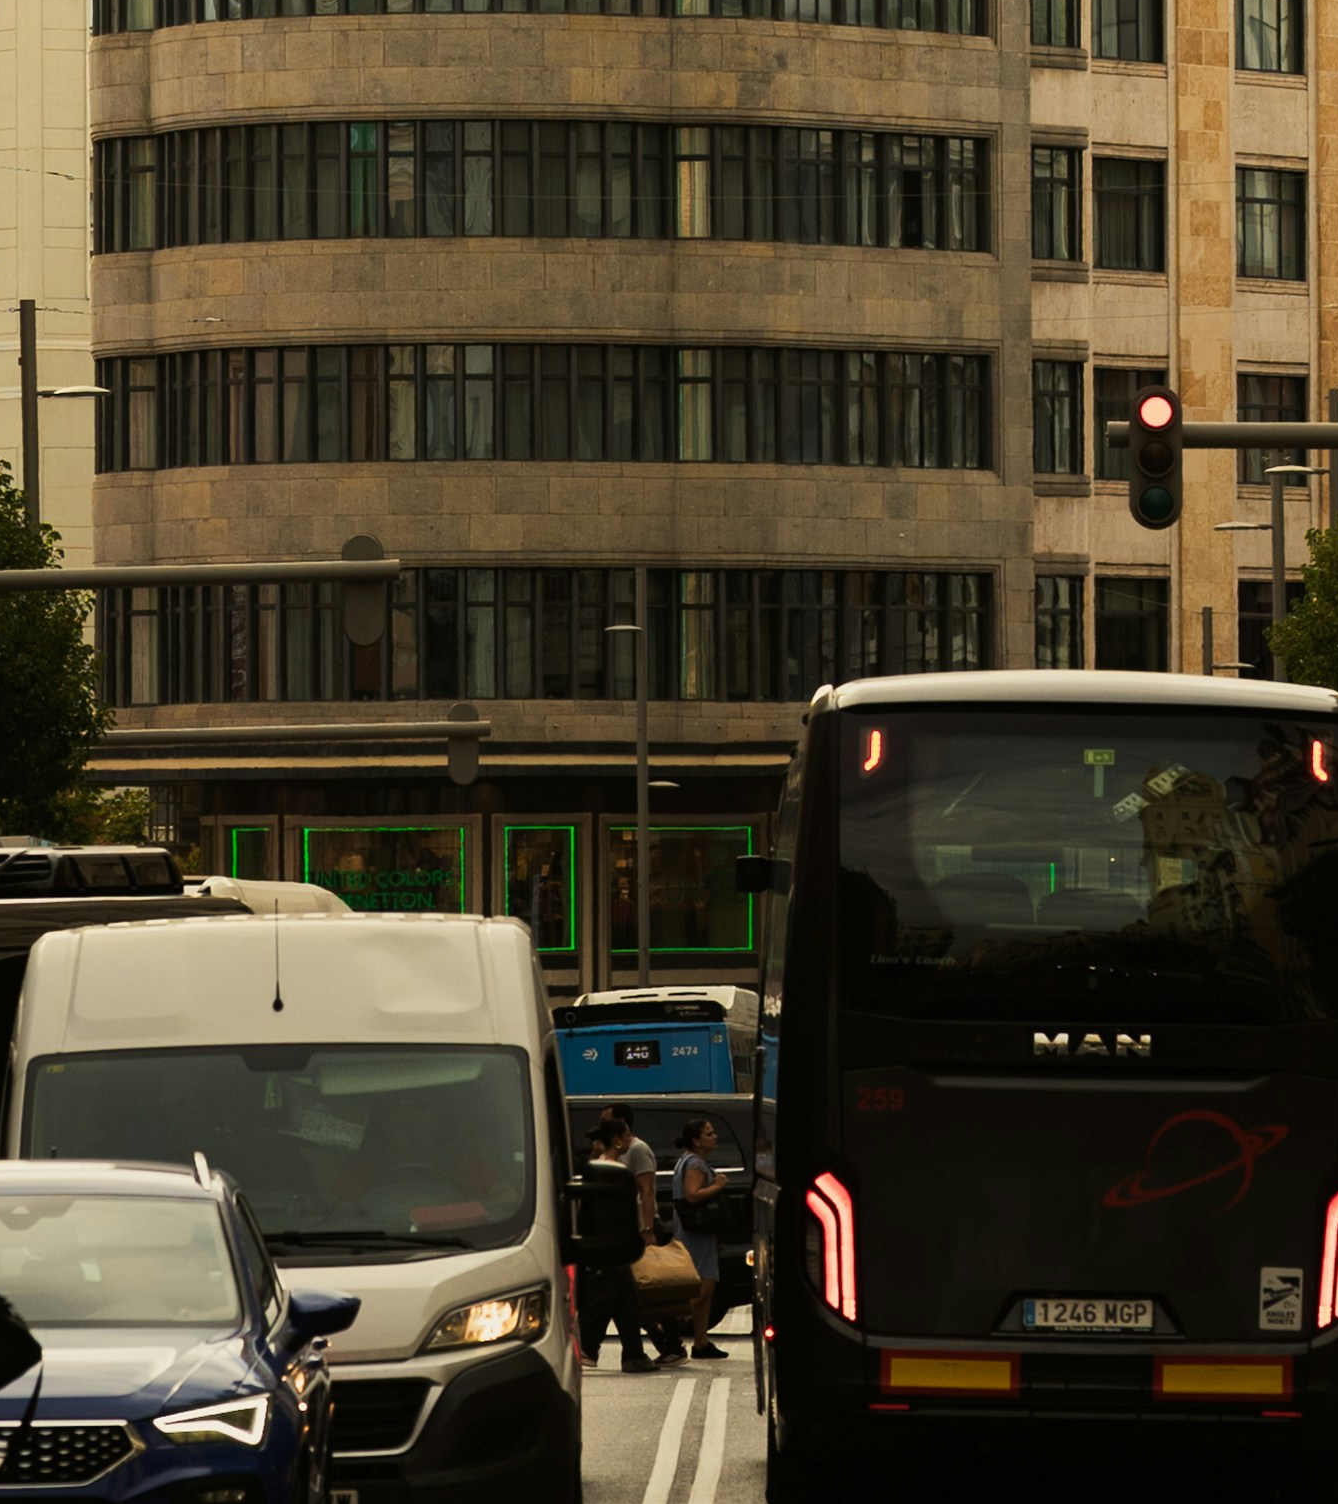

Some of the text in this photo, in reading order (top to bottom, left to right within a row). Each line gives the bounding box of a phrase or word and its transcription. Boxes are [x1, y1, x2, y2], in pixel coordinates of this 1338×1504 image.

[377, 869, 455, 889] COLORS
[672, 1047, 699, 1056] 2474
[1033, 1032, 1152, 1057] MAN
[857, 1088, 904, 1111] 259
[1041, 1302, 1147, 1324] 1246 MGP
